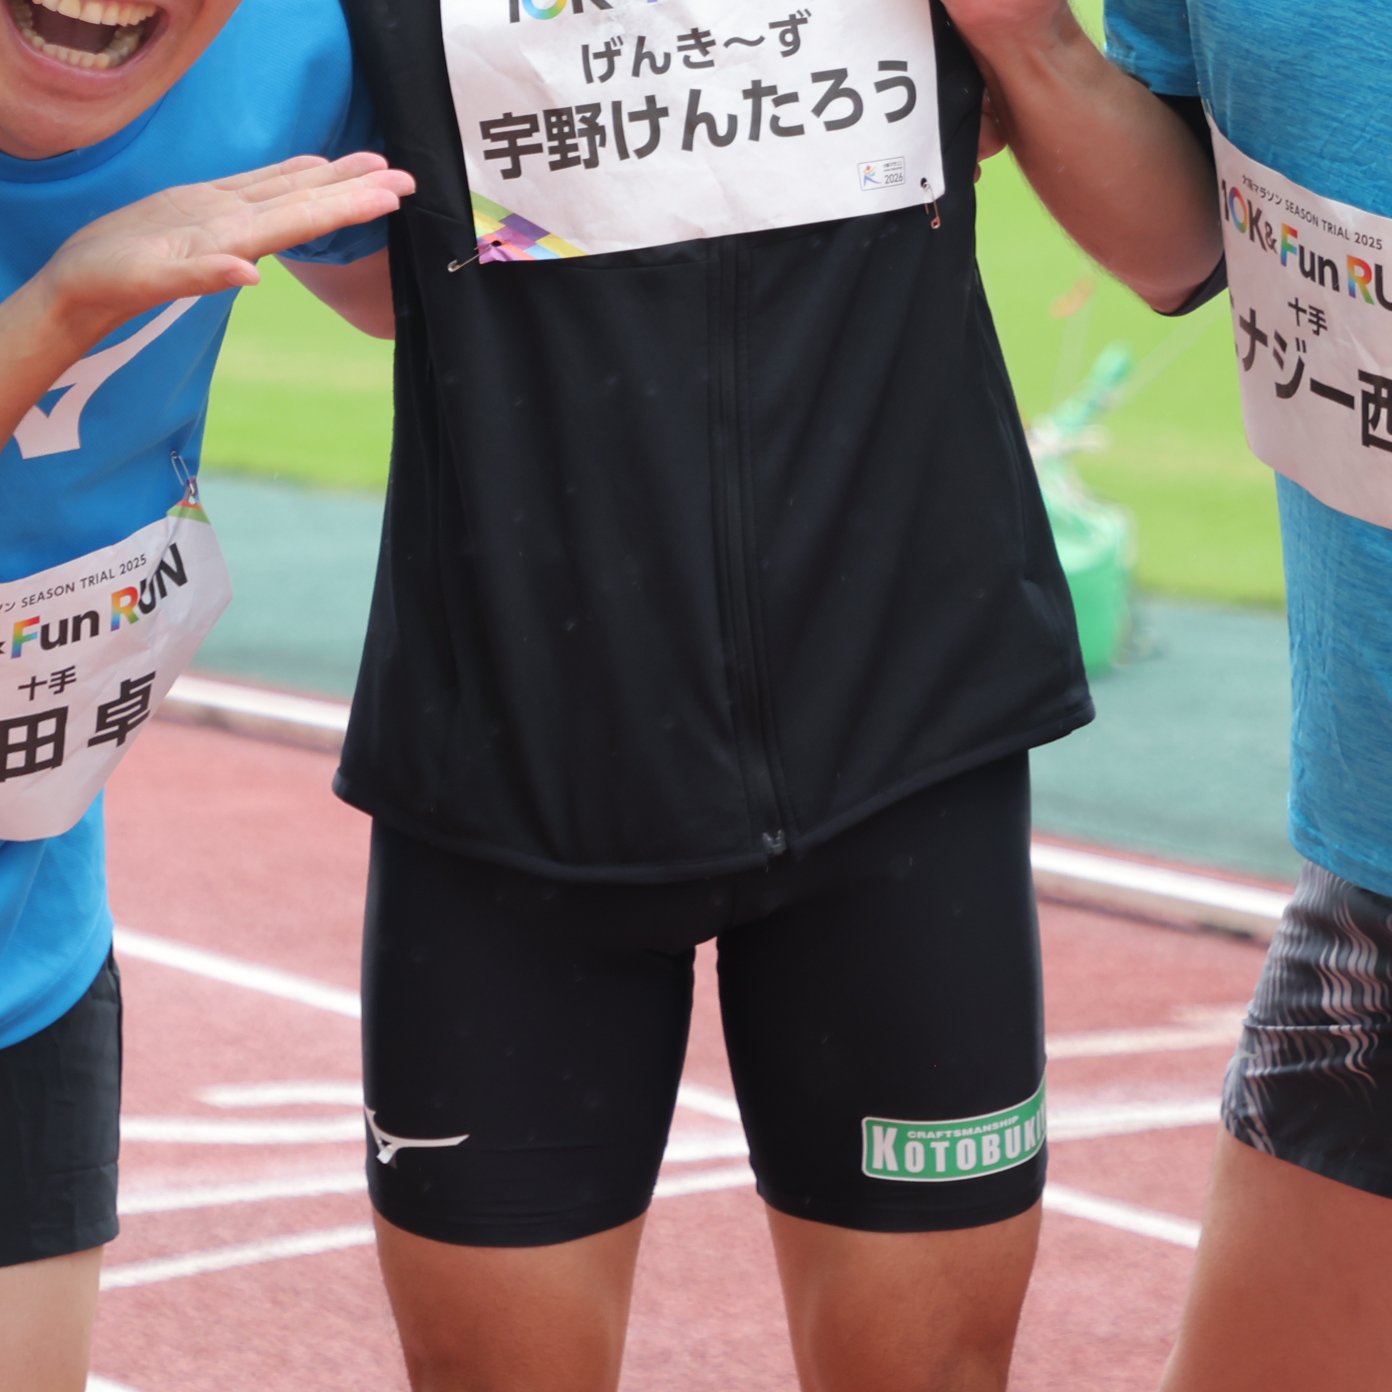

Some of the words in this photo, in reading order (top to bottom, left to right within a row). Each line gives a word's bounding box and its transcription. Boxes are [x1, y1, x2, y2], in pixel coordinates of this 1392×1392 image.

[479, 59, 918, 181] 宇野けんたろう
[884, 172, 904, 184] 2026
[1285, 199, 1319, 227] SEASON
[1321, 219, 1350, 241] TRIAL
[1354, 232, 1383, 251] 2025
[1287, 297, 1328, 336] 十手
[21, 582, 75, 608] SEASON
[80, 568, 116, 589] TRIAL
[119, 554, 147, 576] 2025
[110, 542, 189, 632] RUN
[18, 665, 77, 701] 十手
[871, 1098, 1046, 1173] KOTOBUKI
[907, 1115, 1020, 1140] CRAFTSMANSHIP
